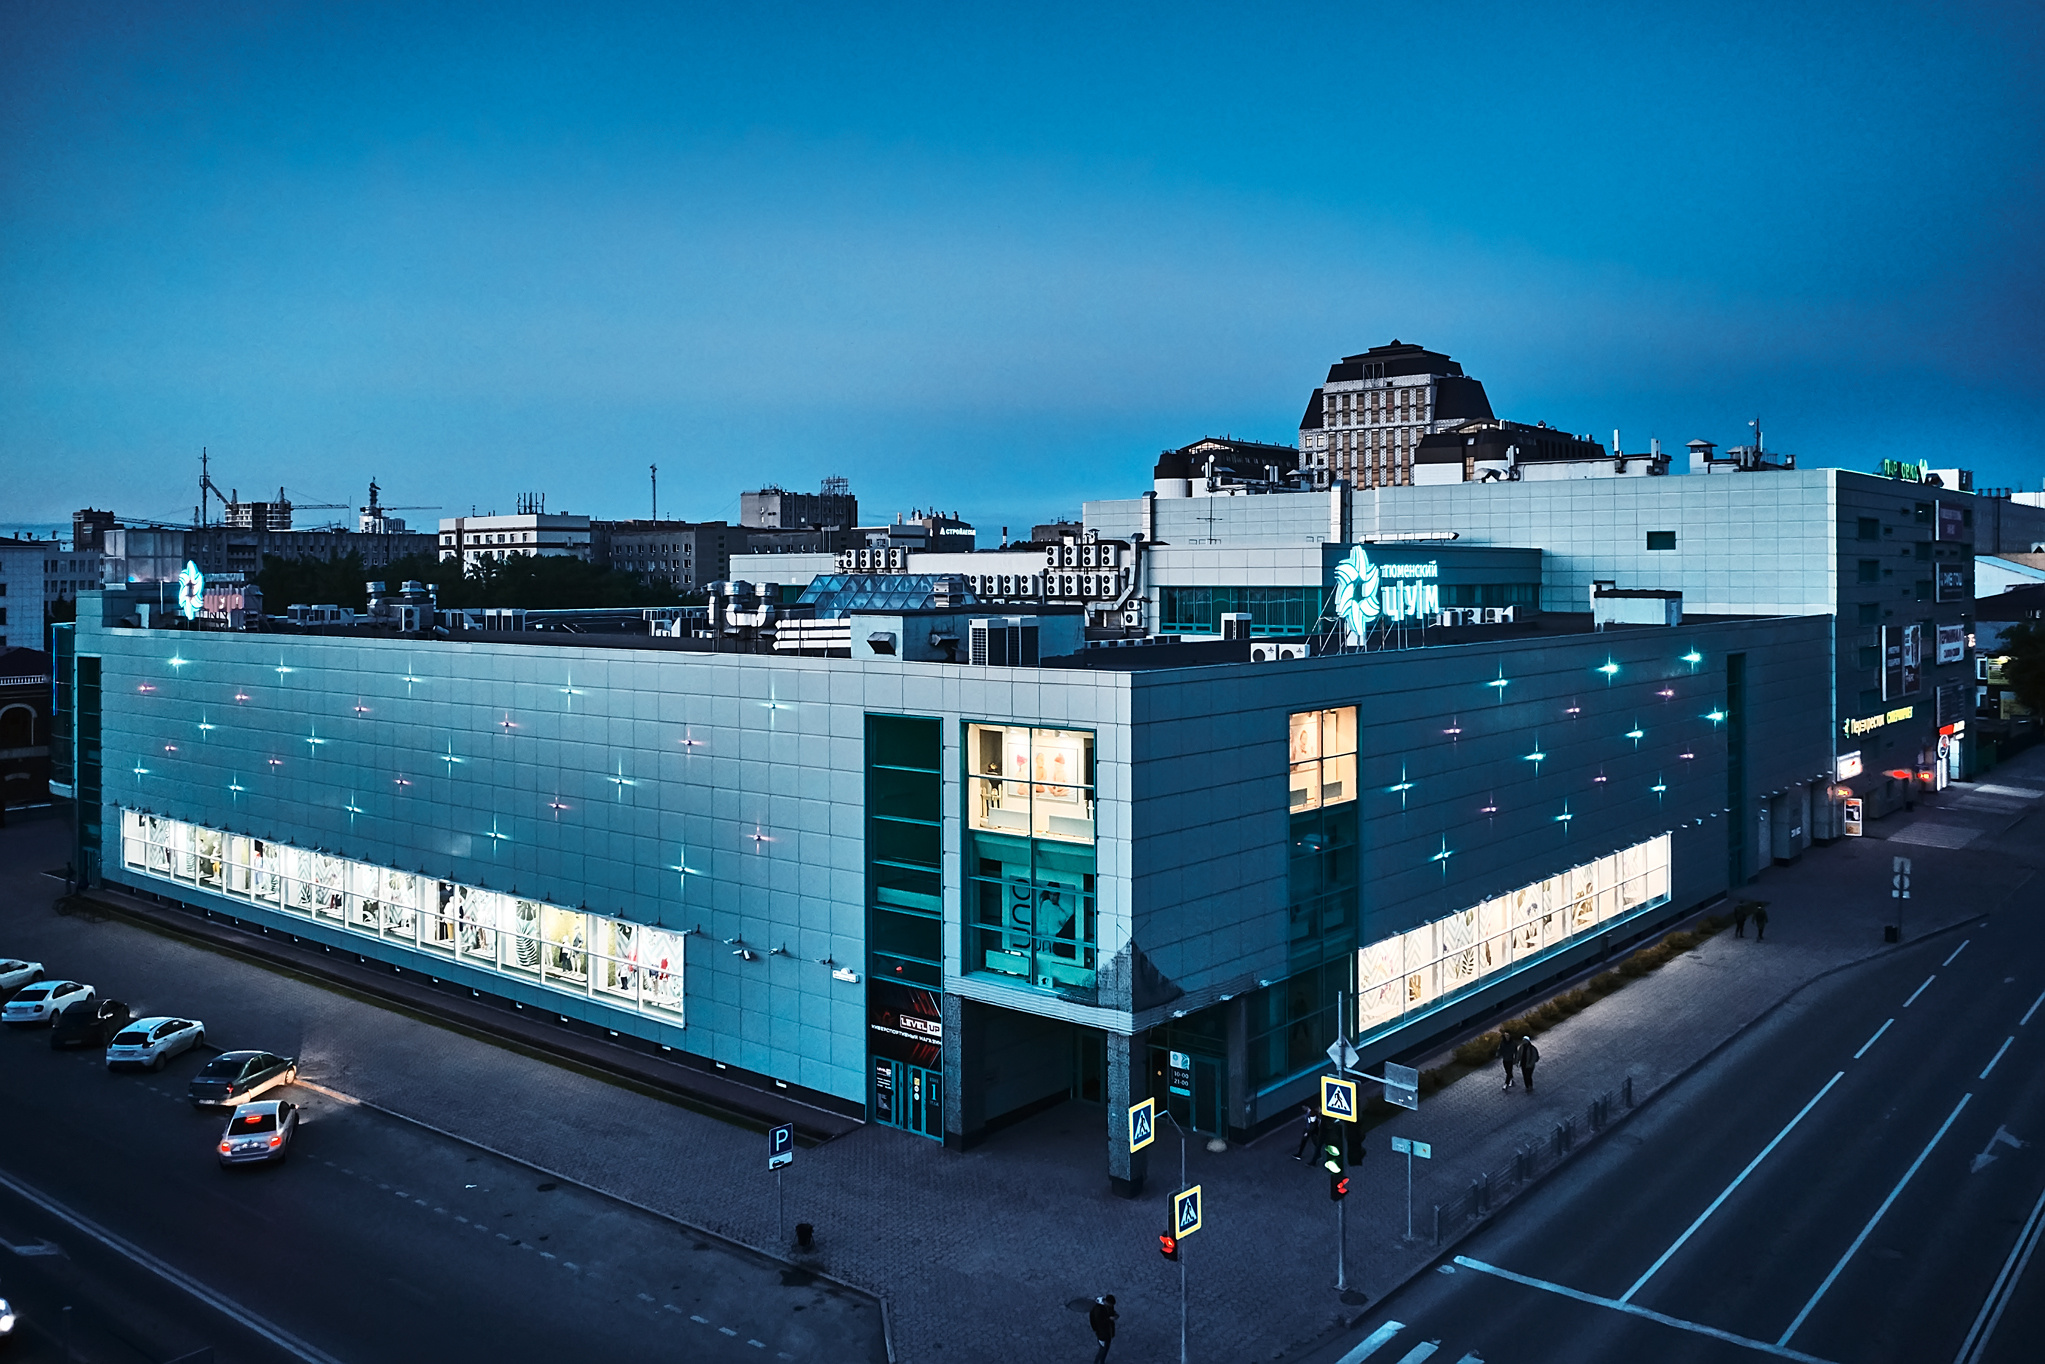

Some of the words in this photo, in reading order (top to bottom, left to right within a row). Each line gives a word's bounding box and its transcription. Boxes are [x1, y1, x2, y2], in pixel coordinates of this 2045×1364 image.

[900, 1016, 928, 1031] LEVEL
[928, 1023, 941, 1033] UP
[931, 1083, 937, 1101] 1
[775, 1128, 789, 1152] P
